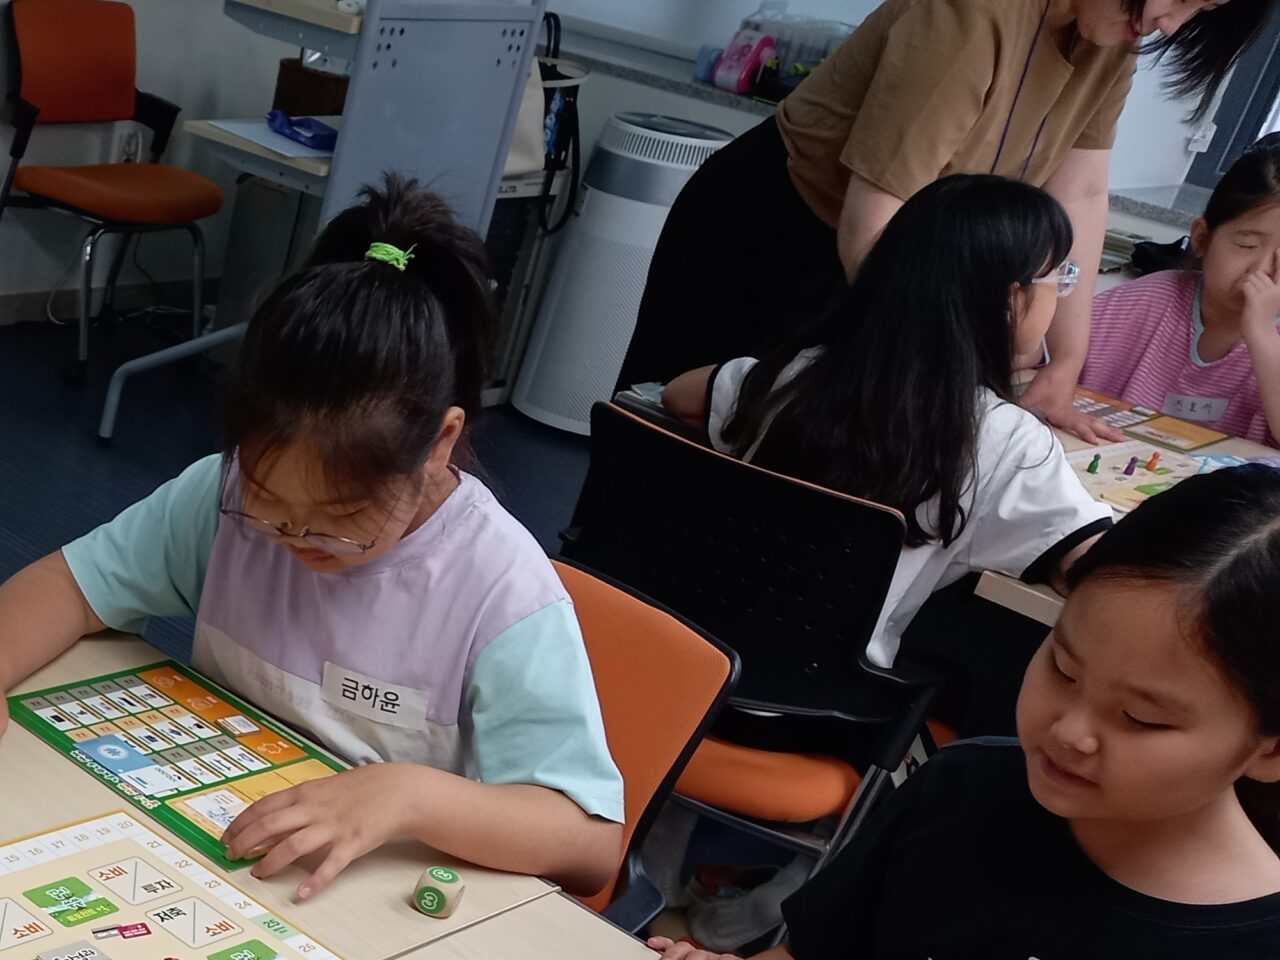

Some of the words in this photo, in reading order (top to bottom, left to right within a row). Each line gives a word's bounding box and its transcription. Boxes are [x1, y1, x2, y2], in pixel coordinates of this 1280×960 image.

[341, 676, 401, 715] 금하윤
[117, 820, 133, 830] 20
[96, 827, 111, 836] 19
[73, 834, 89, 842] 18
[51, 840, 66, 849] 17
[147, 840, 163, 849] 21
[28, 848, 44, 856] 16
[4, 854, 20, 864] 15
[174, 859, 192, 868] 22
[98, 865, 128, 882] 소비
[141, 878, 174, 894] 투자
[204, 879, 221, 889] 23
[235, 900, 252, 910] 24
[153, 906, 187, 923] 저축
[204, 920, 236, 938] 소비
[262, 918, 281, 930] 25
[12, 921, 45, 940] 소비
[298, 943, 316, 953] 26
